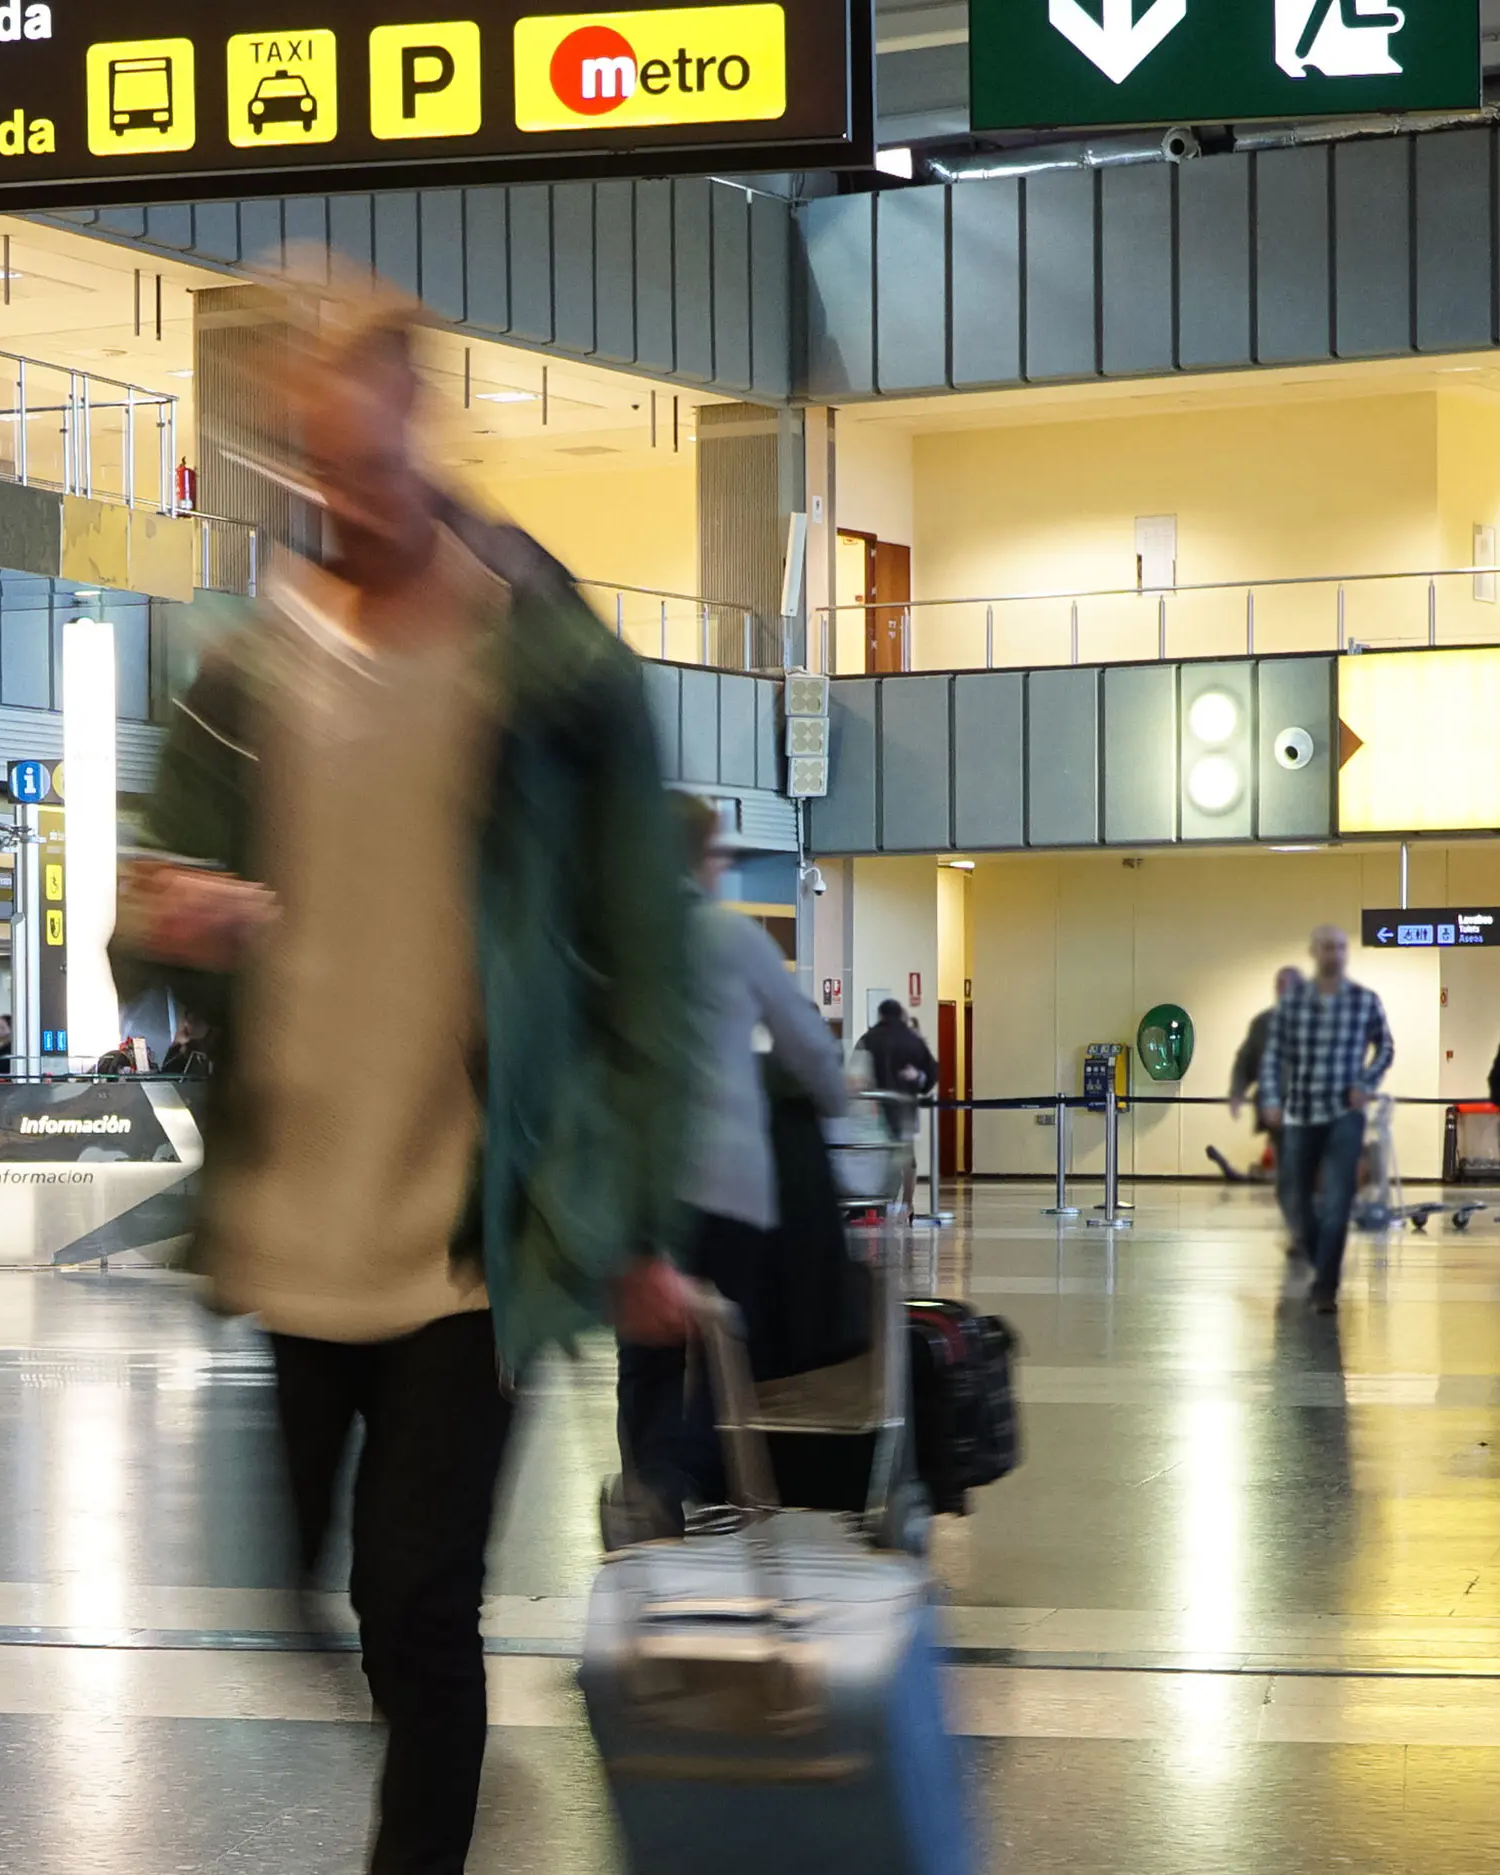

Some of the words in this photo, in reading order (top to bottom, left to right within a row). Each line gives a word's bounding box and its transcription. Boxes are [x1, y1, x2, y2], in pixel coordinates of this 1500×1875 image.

[250, 40, 313, 63] TAXI
[402, 45, 455, 119] P
[582, 48, 750, 99] metro
[20, 1115, 131, 1134] Información
